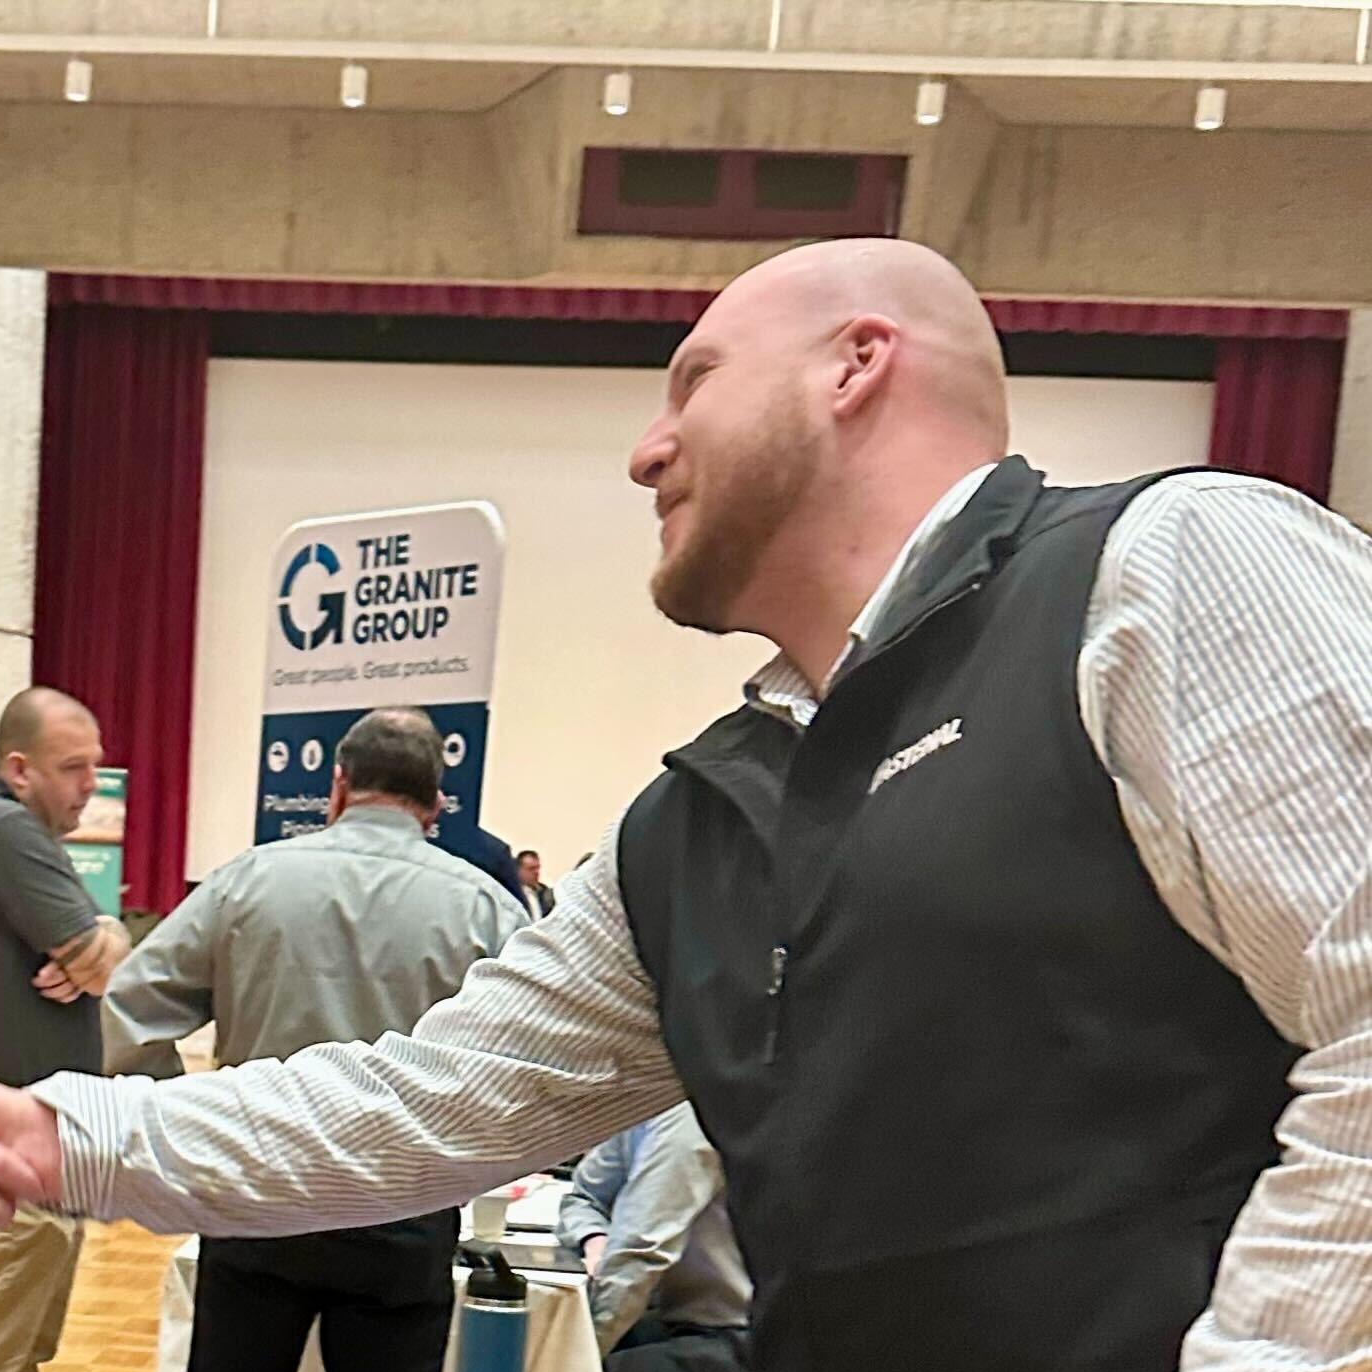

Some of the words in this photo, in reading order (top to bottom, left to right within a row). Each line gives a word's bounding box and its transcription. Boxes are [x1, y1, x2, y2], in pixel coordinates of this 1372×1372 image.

[357, 533, 411, 570] THE
[355, 563, 480, 607] GRANITE
[352, 606, 449, 645] GROUP
[273, 668, 308, 687] Great
[363, 660, 400, 680] Great
